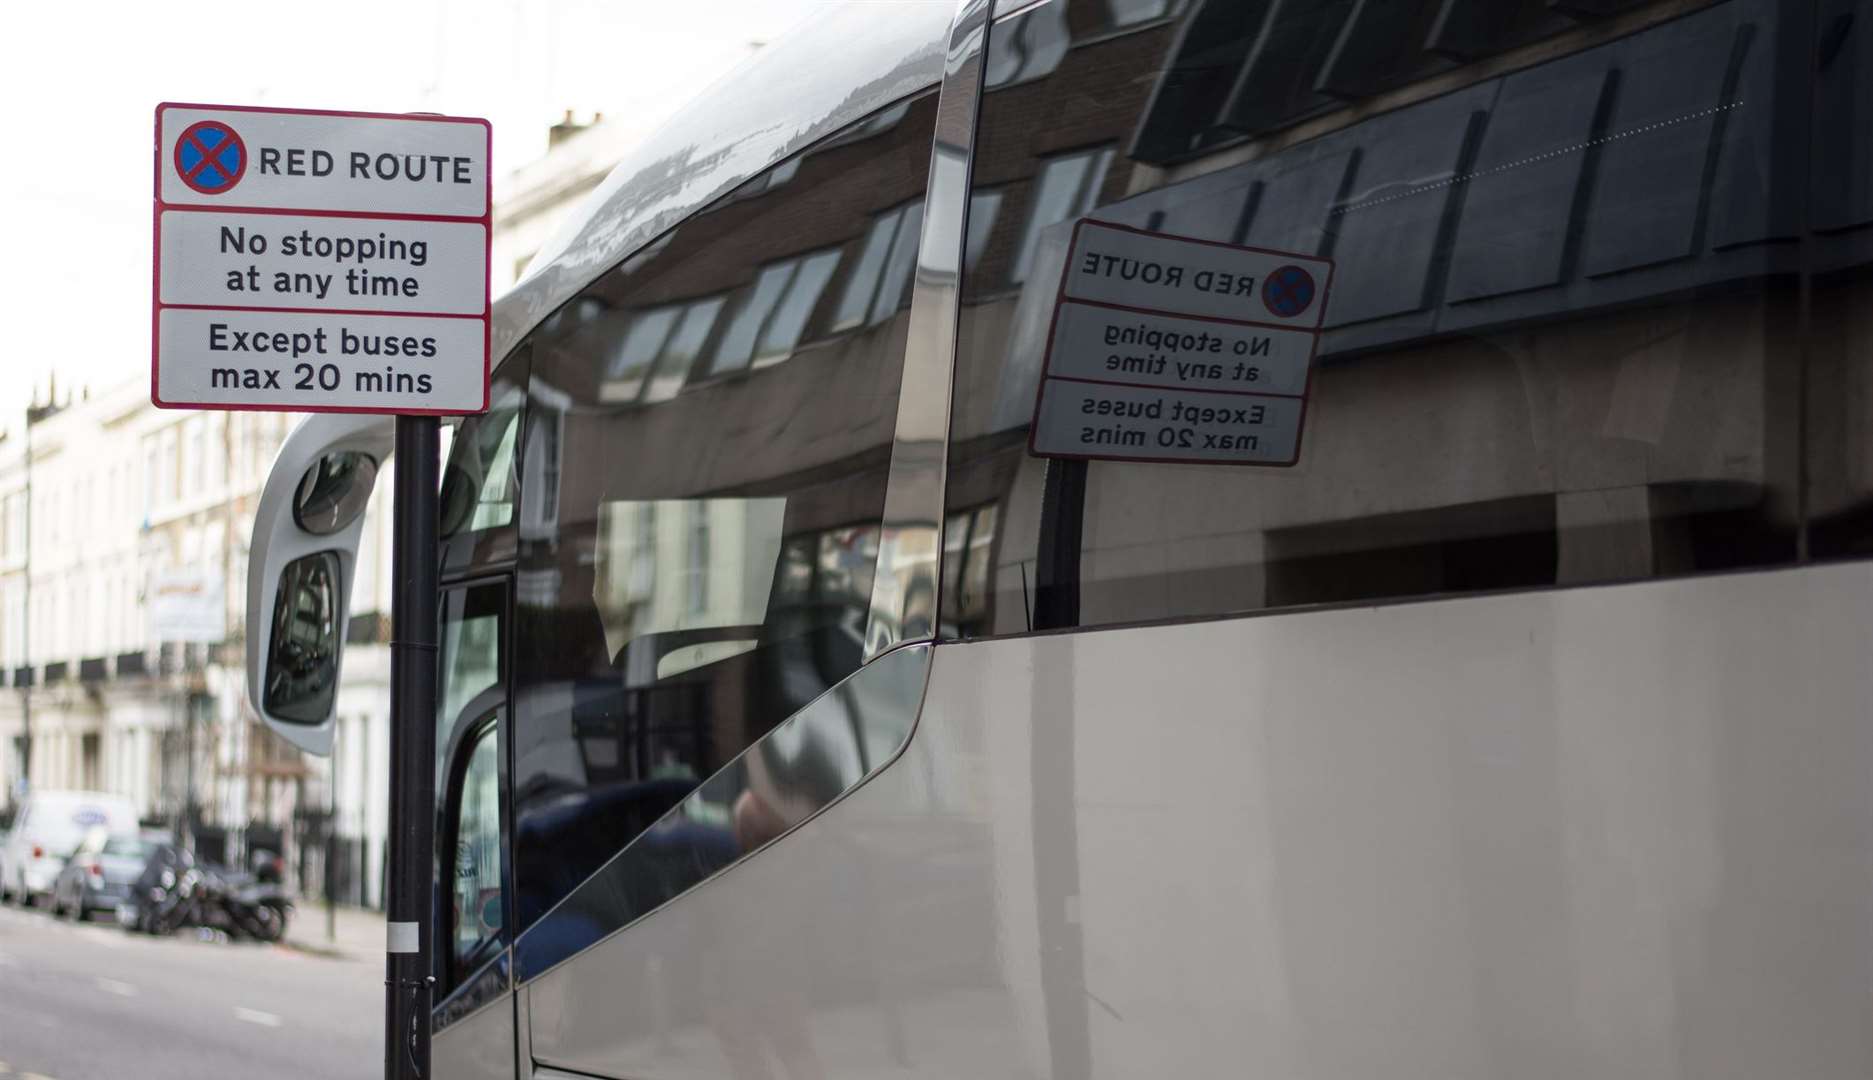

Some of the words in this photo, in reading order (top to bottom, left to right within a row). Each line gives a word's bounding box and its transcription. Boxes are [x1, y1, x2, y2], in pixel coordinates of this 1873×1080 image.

[260, 148, 334, 177] RED
[350, 152, 472, 184] ROUTE
[220, 226, 267, 255] No
[281, 230, 428, 266] stopping
[227, 266, 260, 292] at
[273, 271, 332, 299] any
[346, 269, 419, 297] time
[210, 324, 327, 358] Except
[341, 328, 437, 358] buses
[211, 367, 281, 390] max
[294, 363, 340, 391] 20
[355, 366, 433, 394] mins
